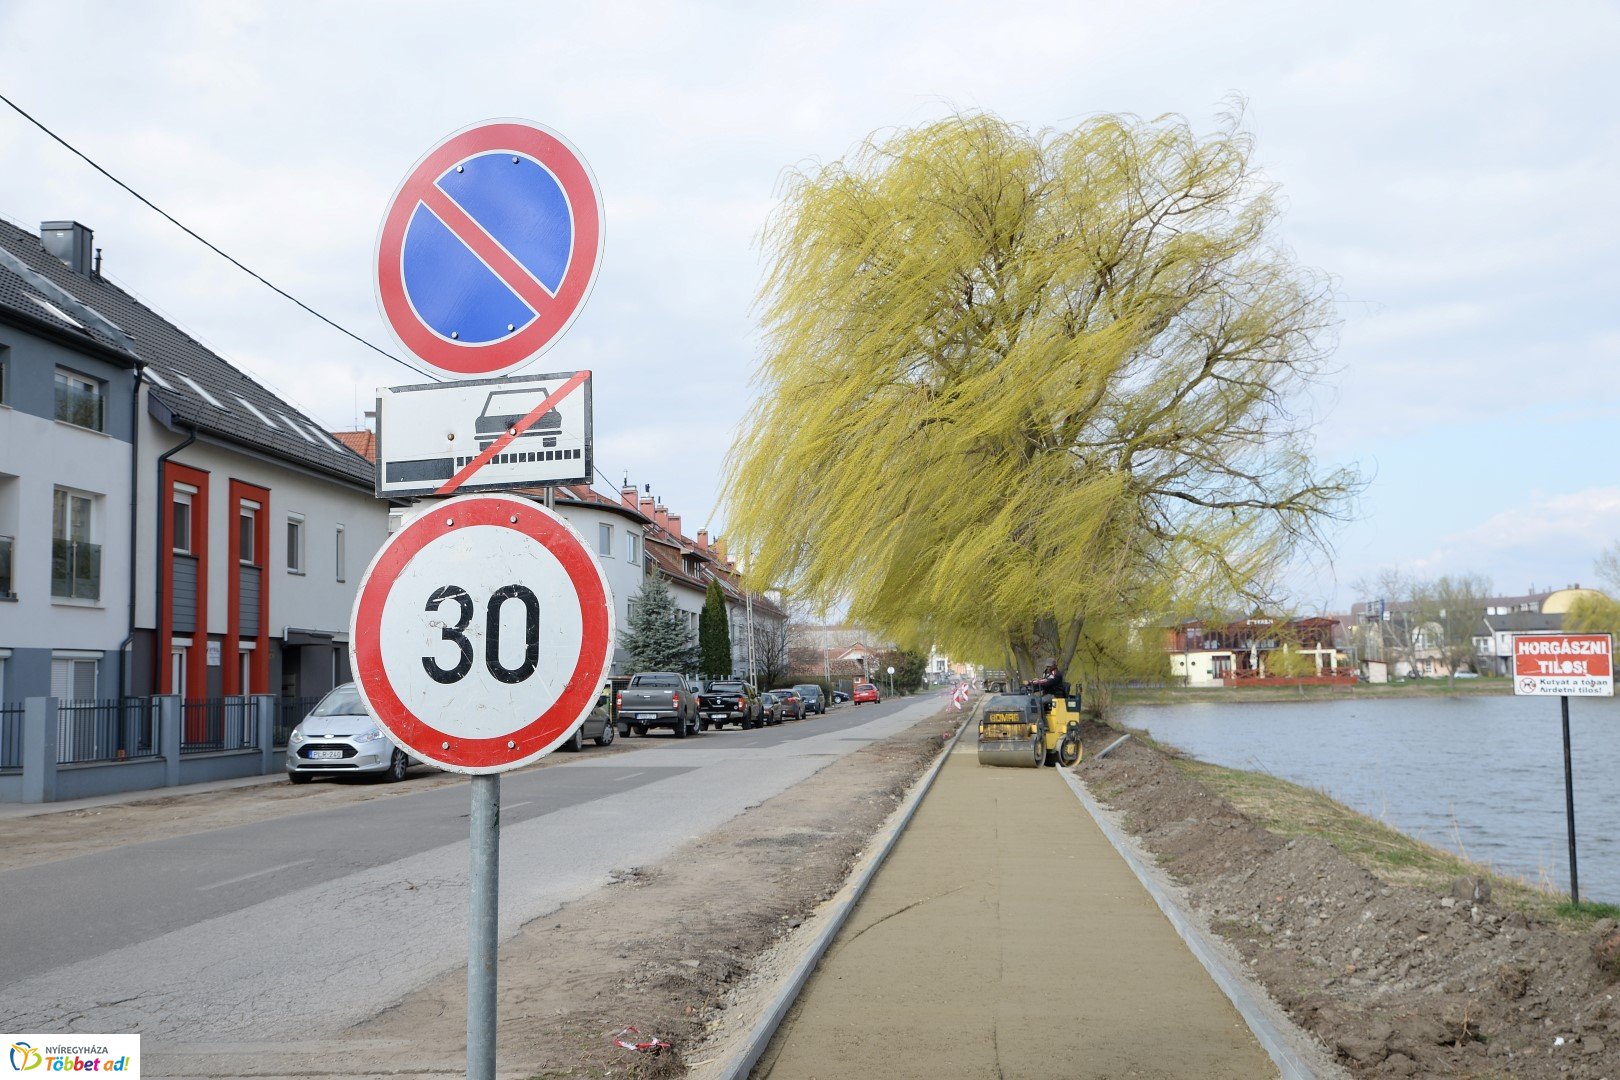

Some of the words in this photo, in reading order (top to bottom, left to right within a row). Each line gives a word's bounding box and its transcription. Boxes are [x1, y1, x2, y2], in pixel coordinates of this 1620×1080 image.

[422, 584, 540, 684] 30
[1518, 638, 1607, 655] HORGÁSZNI
[1538, 660, 1588, 674] TILOS!
